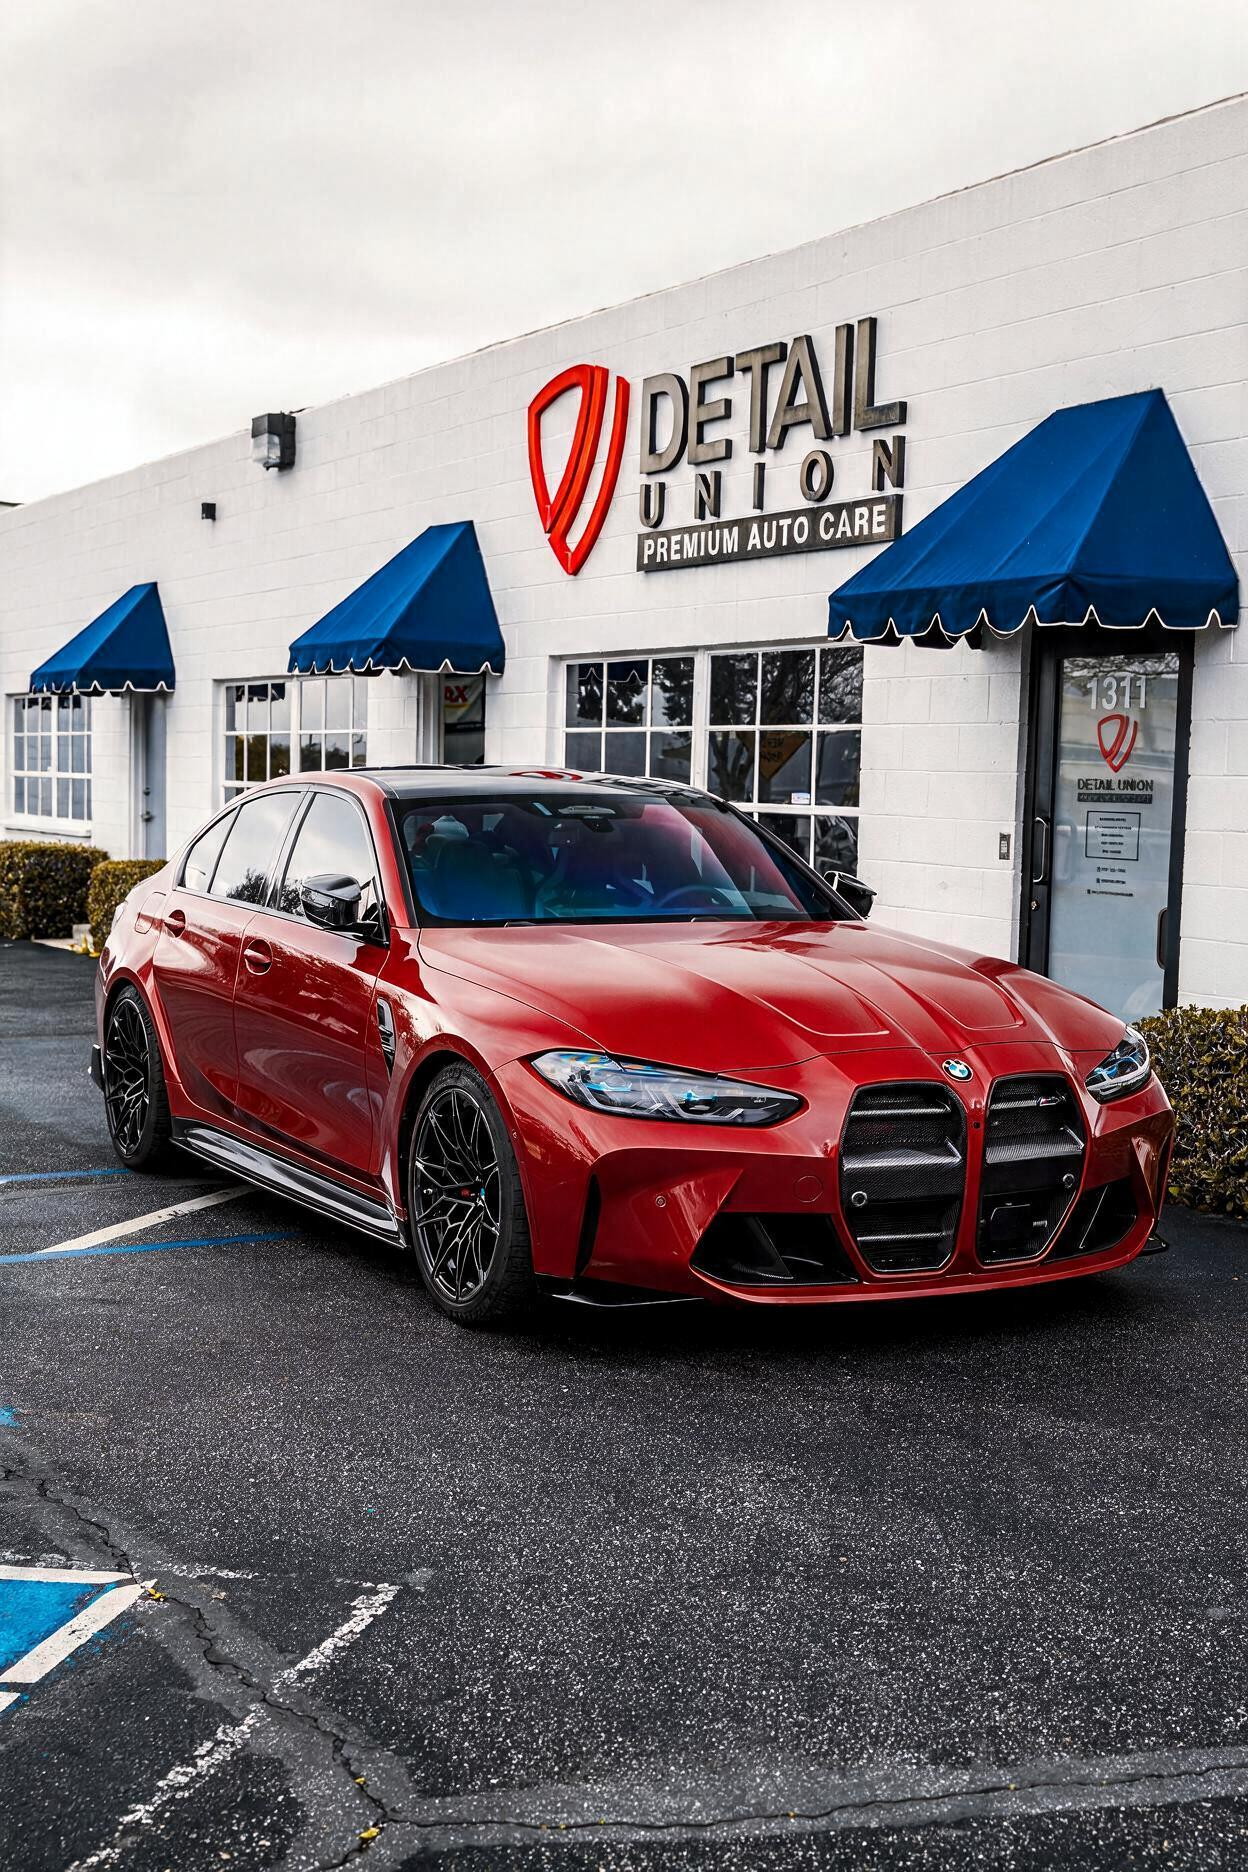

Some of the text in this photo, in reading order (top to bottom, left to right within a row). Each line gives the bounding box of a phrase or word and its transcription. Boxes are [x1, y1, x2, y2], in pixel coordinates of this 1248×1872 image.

[640, 317, 907, 474] DETAIL
[639, 435, 906, 528] UNION
[643, 504, 887, 564] PREMIUM AUTO CARE
[1087, 674, 1146, 710] 1311
[1077, 778, 1154, 792] DETAIL UNION
